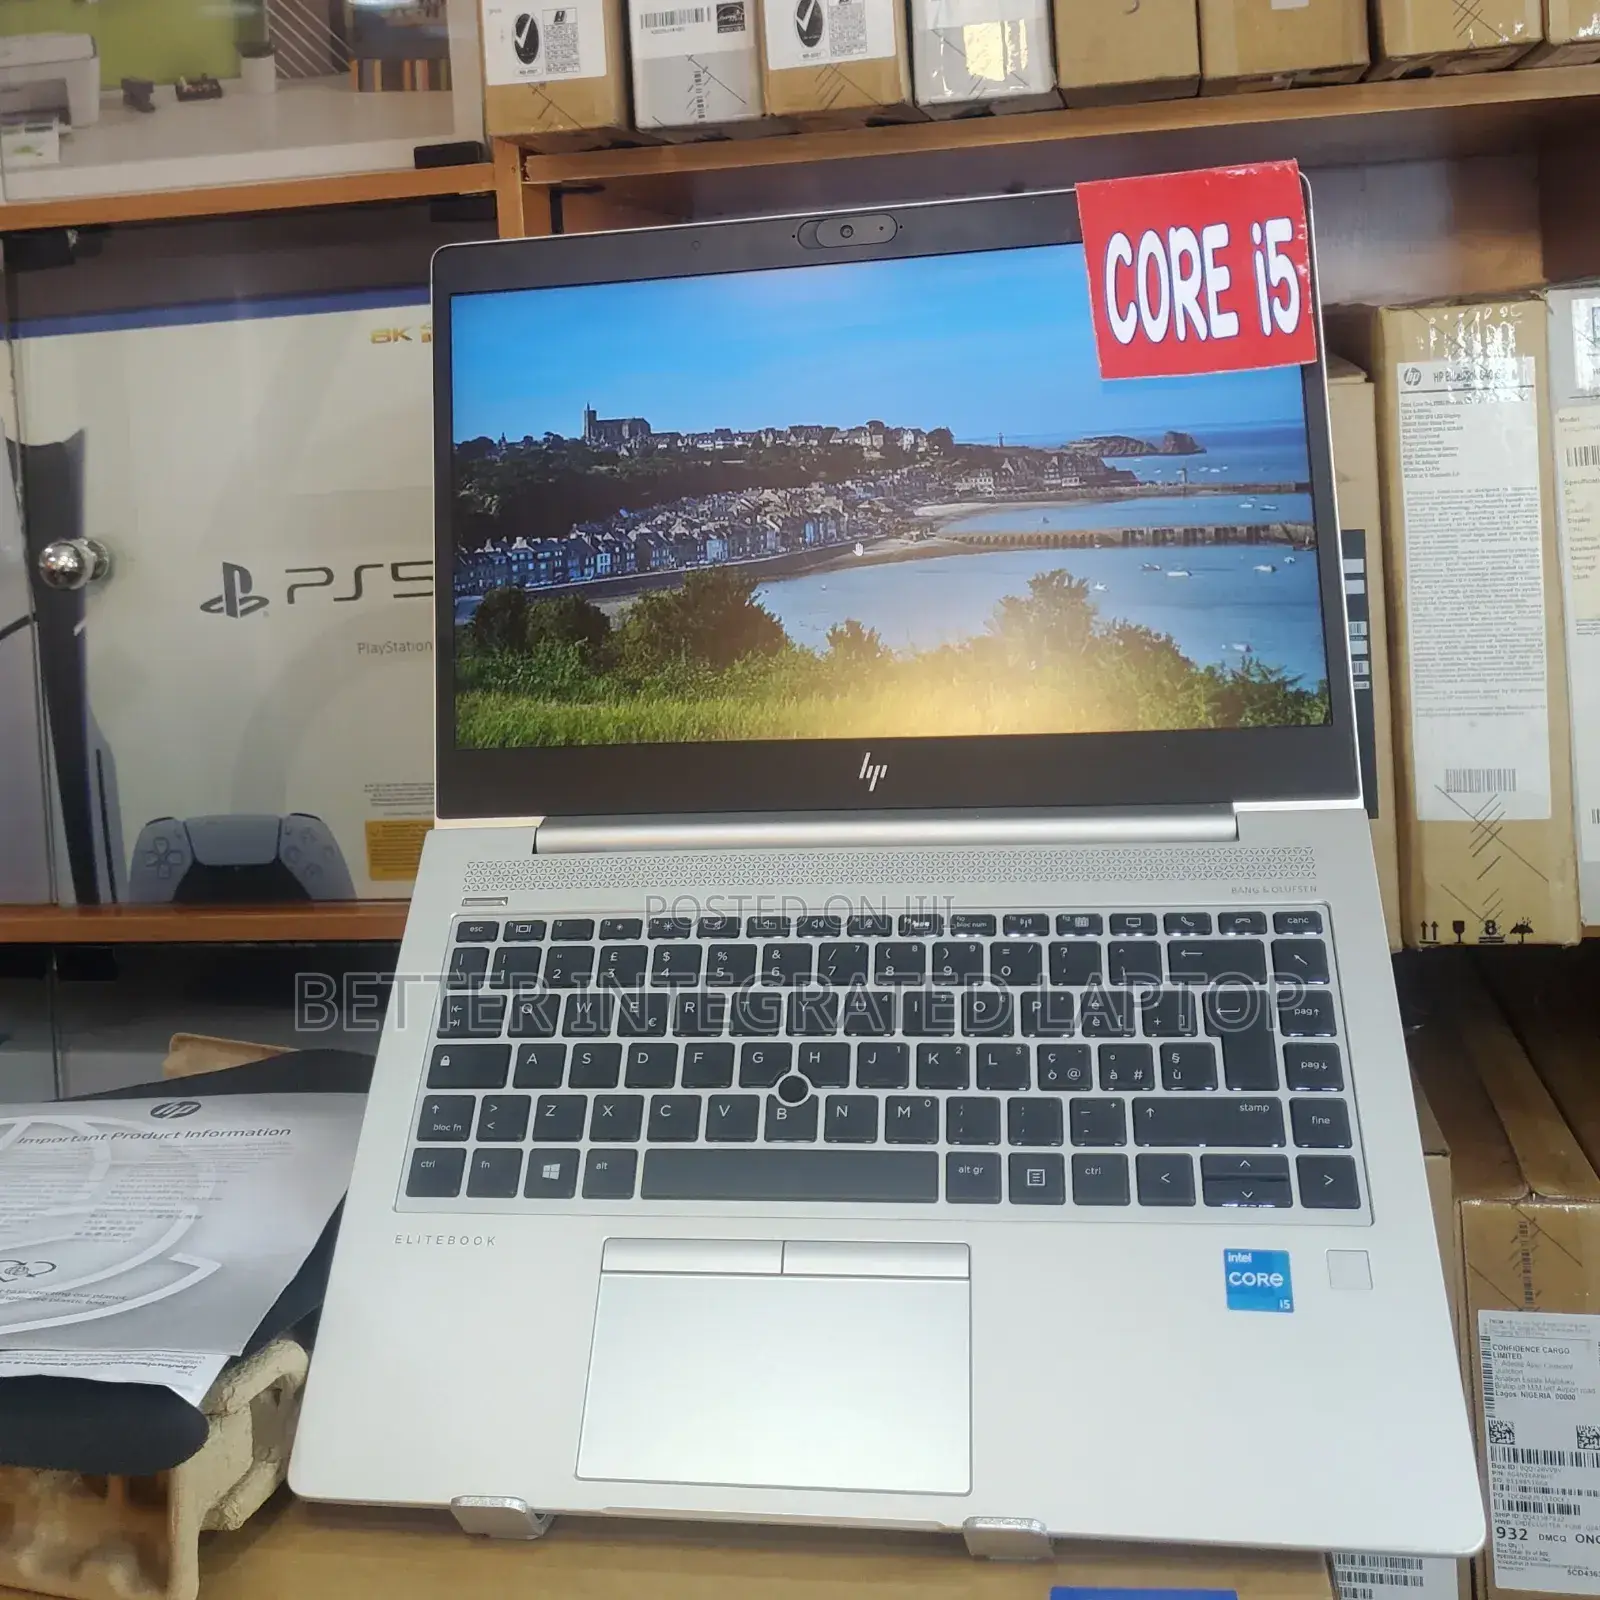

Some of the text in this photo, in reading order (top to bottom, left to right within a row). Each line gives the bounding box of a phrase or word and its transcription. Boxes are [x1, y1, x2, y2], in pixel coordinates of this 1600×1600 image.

[1105, 216, 1300, 345] CORE i5
[370, 327, 412, 345] 8K
[285, 560, 434, 604] PS5
[357, 640, 433, 656] PlayStation
[859, 752, 888, 792] hp
[1231, 886, 1260, 896] BANG
[1272, 885, 1318, 895] OLUFSEN
[1287, 917, 1310, 925] canc
[610, 952, 618, 962] £
[662, 951, 671, 962] $
[717, 952, 728, 962] %
[772, 950, 782, 960] &
[1060, 947, 1068, 957] ?
[552, 968, 562, 979] 2
[608, 968, 616, 978] 3
[660, 968, 670, 977] 4
[716, 967, 725, 978] 5
[772, 967, 780, 977] 6
[828, 966, 837, 977] 7
[885, 966, 895, 976] 8
[943, 966, 952, 976] 9
[521, 1003, 533, 1014] Q
[576, 1002, 592, 1014] W
[630, 1002, 640, 1013] E
[685, 1002, 696, 1013] R
[740, 1002, 751, 1012] T
[798, 1001, 810, 1012] Y
[856, 1001, 867, 1012] U
[1032, 1001, 1042, 1012] P
[1294, 1008, 1312, 1017] pag
[648, 1018, 657, 1028] €
[526, 1053, 538, 1065] A
[582, 1052, 592, 1064] S
[638, 1052, 649, 1064] D
[694, 1052, 704, 1064] F
[752, 1052, 764, 1064] G
[809, 1052, 821, 1064] H
[868, 1052, 877, 1064] J
[928, 1053, 940, 1065] K
[988, 1054, 998, 1066] L
[1301, 1060, 1319, 1071] pag
[1067, 1068, 1081, 1080] @
[1133, 1069, 1144, 1080] #
[545, 1106, 556, 1117] Z
[602, 1106, 615, 1117] X
[660, 1105, 672, 1117] C
[719, 1106, 730, 1116] V
[836, 1106, 848, 1118] N
[898, 1106, 911, 1118] M
[1239, 1103, 1270, 1113] stamp
[776, 1108, 788, 1120] B
[1312, 1116, 1331, 1125] fine
[433, 1124, 462, 1132] bloc fn
[17, 1127, 293, 1145] Important Product Information
[420, 1160, 436, 1168] ctrl
[481, 1160, 490, 1168] fn
[596, 1161, 608, 1170] alt
[958, 1165, 984, 1176] alt gr
[1085, 1166, 1102, 1176] ctrl
[394, 1234, 497, 1247] ELITEBOOK
[1227, 1252, 1252, 1263] intel
[1279, 1299, 1291, 1310] i5
[1492, 1344, 1571, 1356] CONFIDENCE CARGO
[1493, 1352, 1523, 1360] LIMITED
[1521, 1391, 1552, 1400] NIGERIA
[1496, 1526, 1529, 1541] 932
[1538, 1533, 1567, 1543] DMCQ
